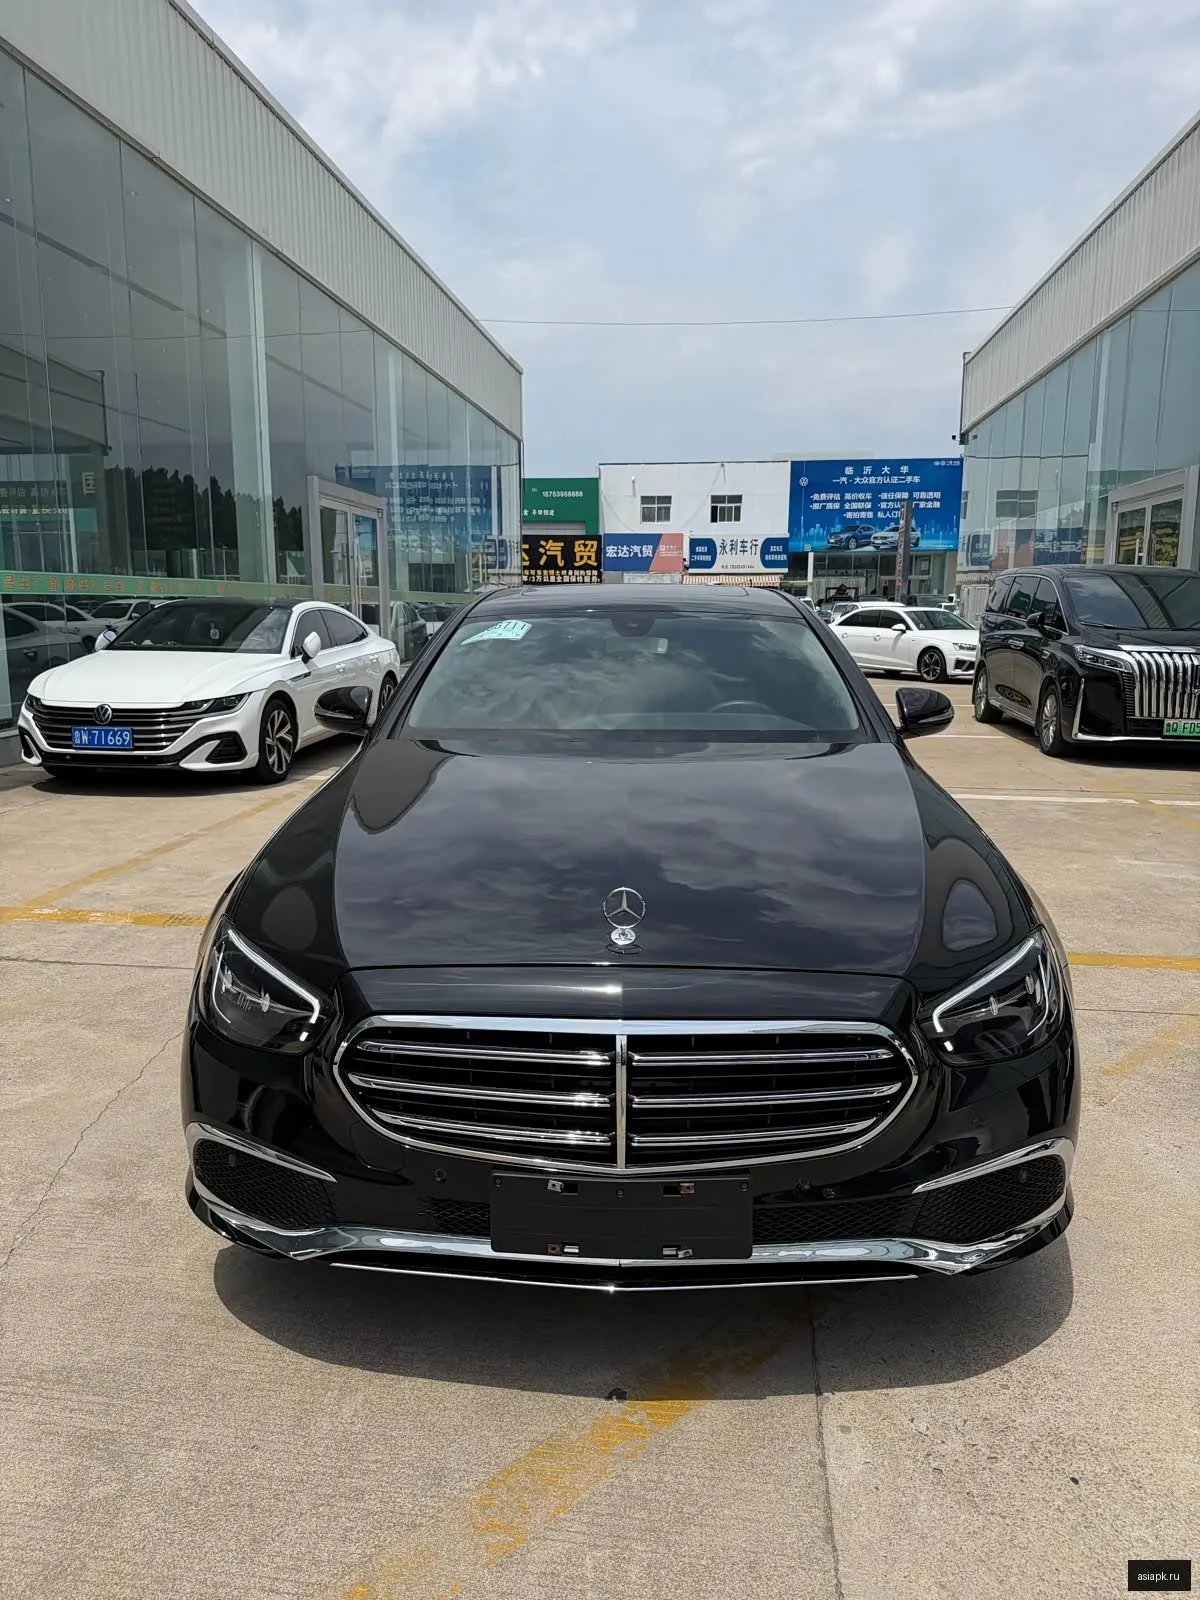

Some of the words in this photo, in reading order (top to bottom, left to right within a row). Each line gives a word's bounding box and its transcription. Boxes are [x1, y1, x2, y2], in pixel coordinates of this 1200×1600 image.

[812, 493, 841, 501] 免费评估
[844, 493, 872, 501] 高价收车
[913, 491, 941, 499] 可靠透明
[812, 502, 840, 510] 原厂质保
[844, 502, 872, 510] 全国联保
[605, 545, 653, 558] 宏达汽贸
[718, 538, 759, 556] 永利车行
